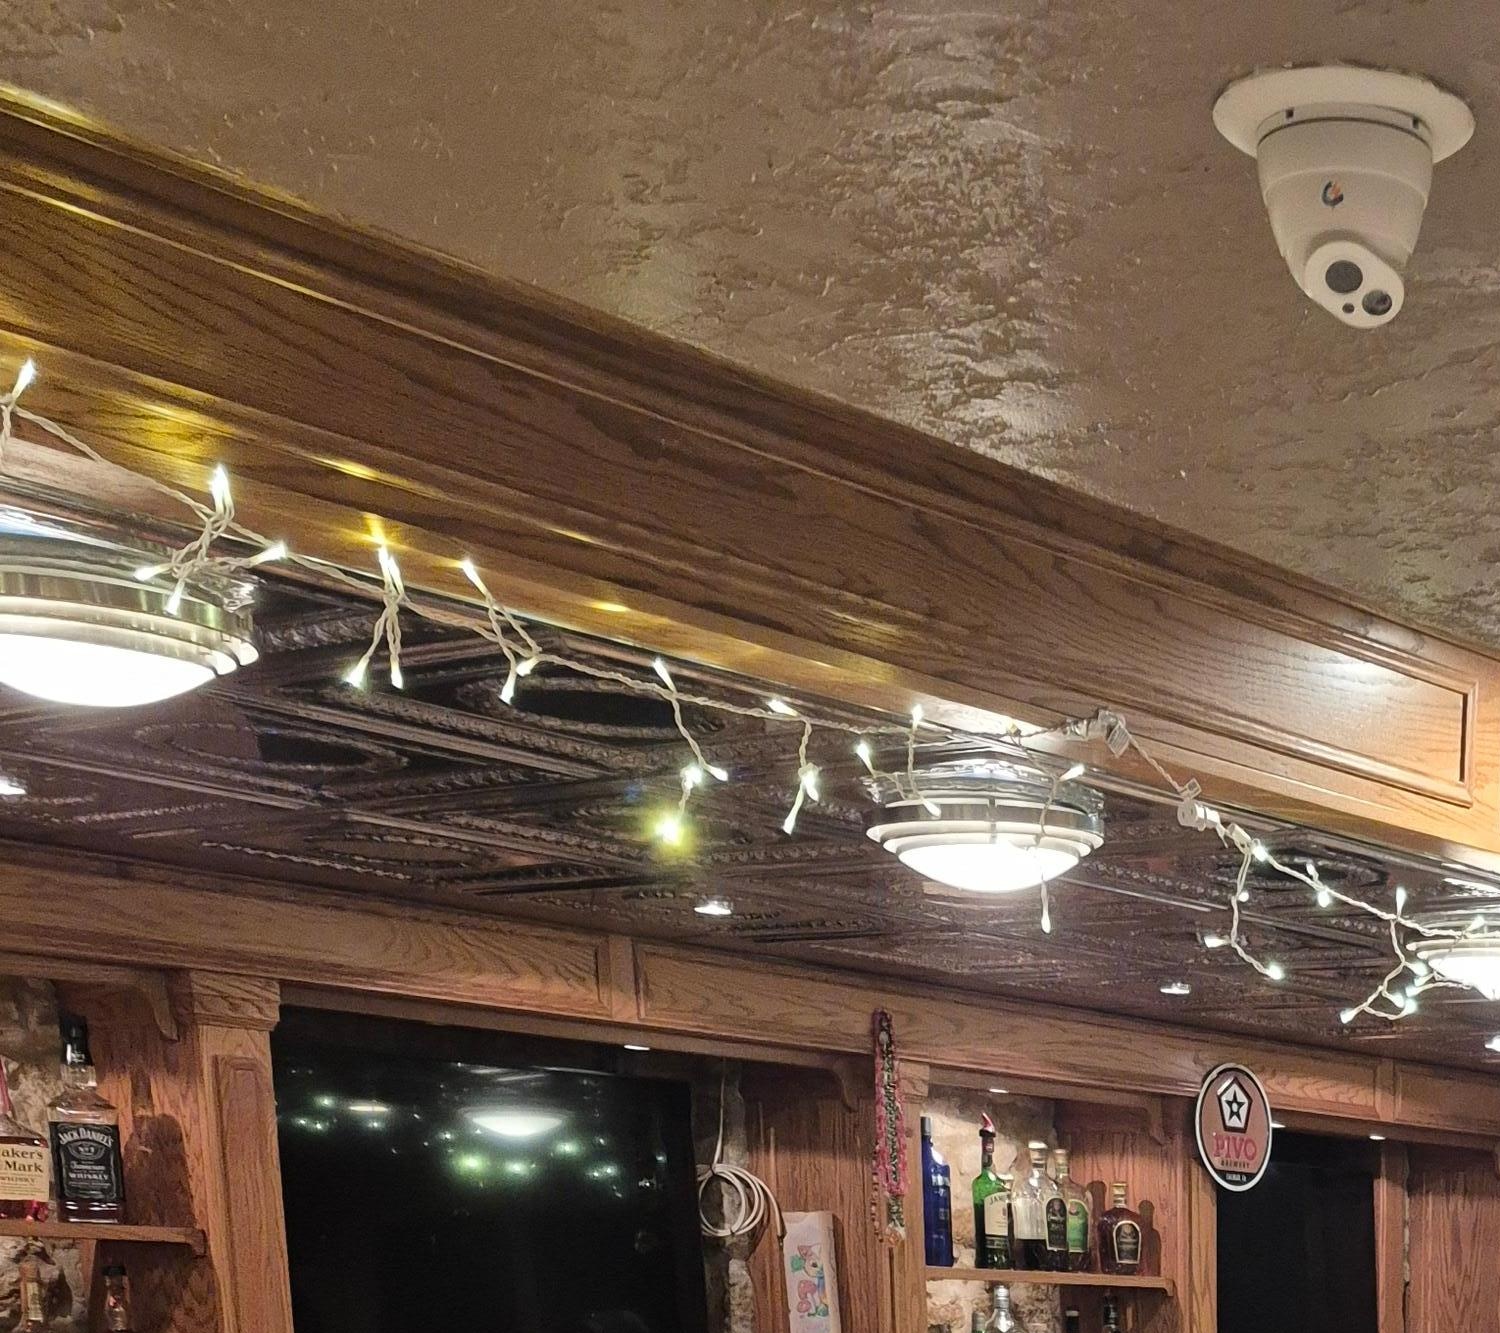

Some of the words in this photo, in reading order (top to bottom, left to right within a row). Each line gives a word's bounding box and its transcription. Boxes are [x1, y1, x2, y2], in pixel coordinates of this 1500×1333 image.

[58, 1131, 79, 1145] JACK
[79, 1128, 114, 1147] DANIEL'S
[0, 1148, 44, 1160] aker's
[1213, 1133, 1257, 1161] PIVO
[4, 1160, 44, 1173] Mark
